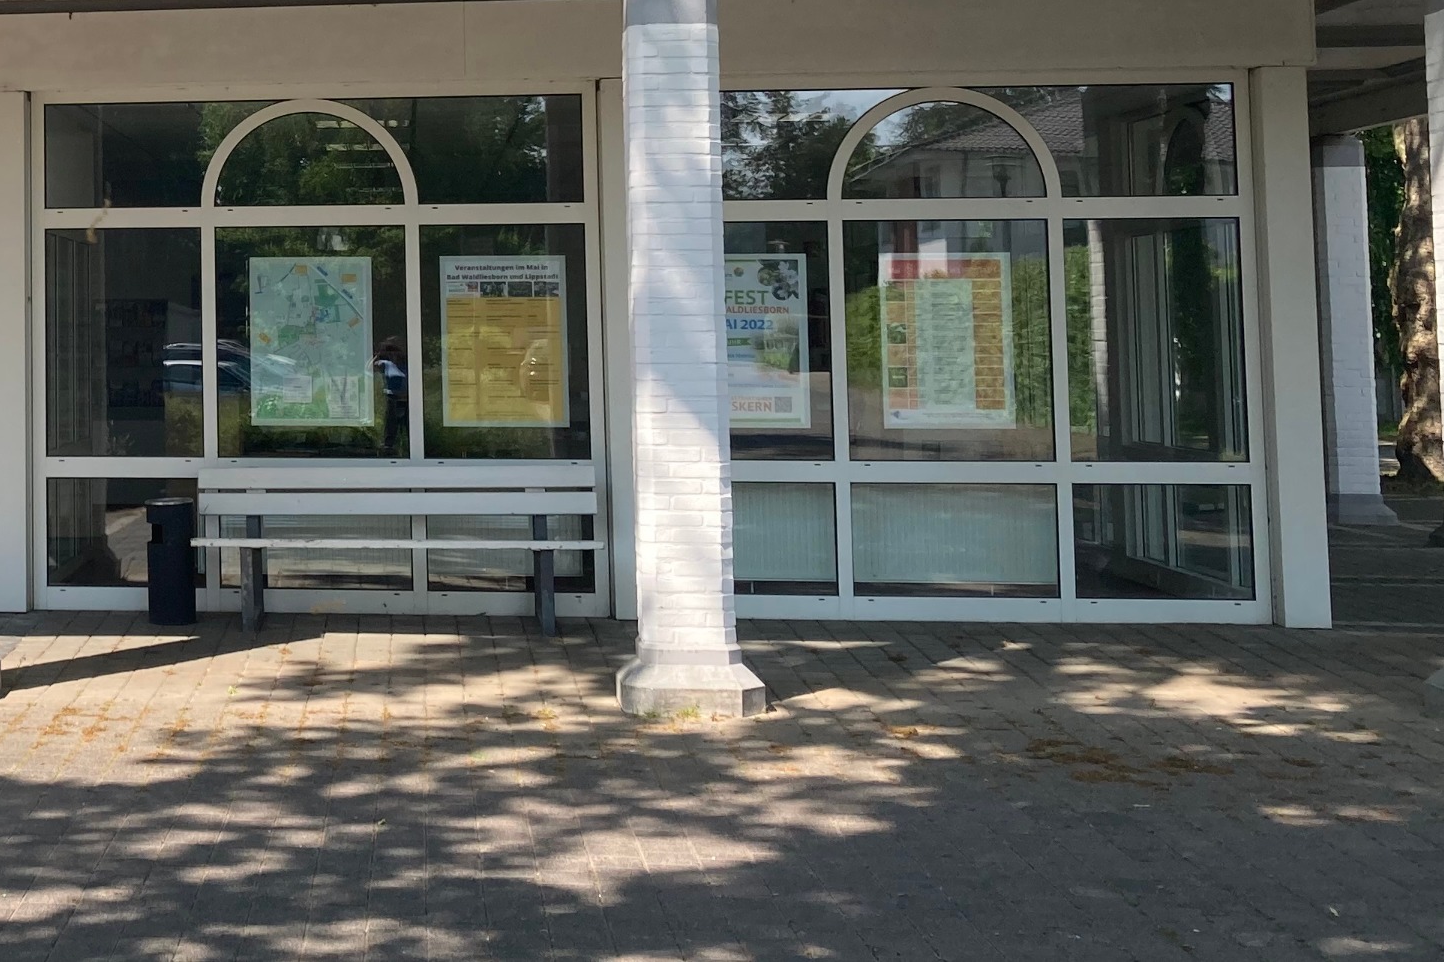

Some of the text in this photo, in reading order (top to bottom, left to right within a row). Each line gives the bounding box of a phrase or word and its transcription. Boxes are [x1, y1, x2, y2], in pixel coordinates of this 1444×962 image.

[724, 289, 770, 305] FEST
[726, 305, 790, 314] ALDLIESBORN
[726, 318, 774, 330] AI 2022
[731, 401, 773, 413] SKERN
